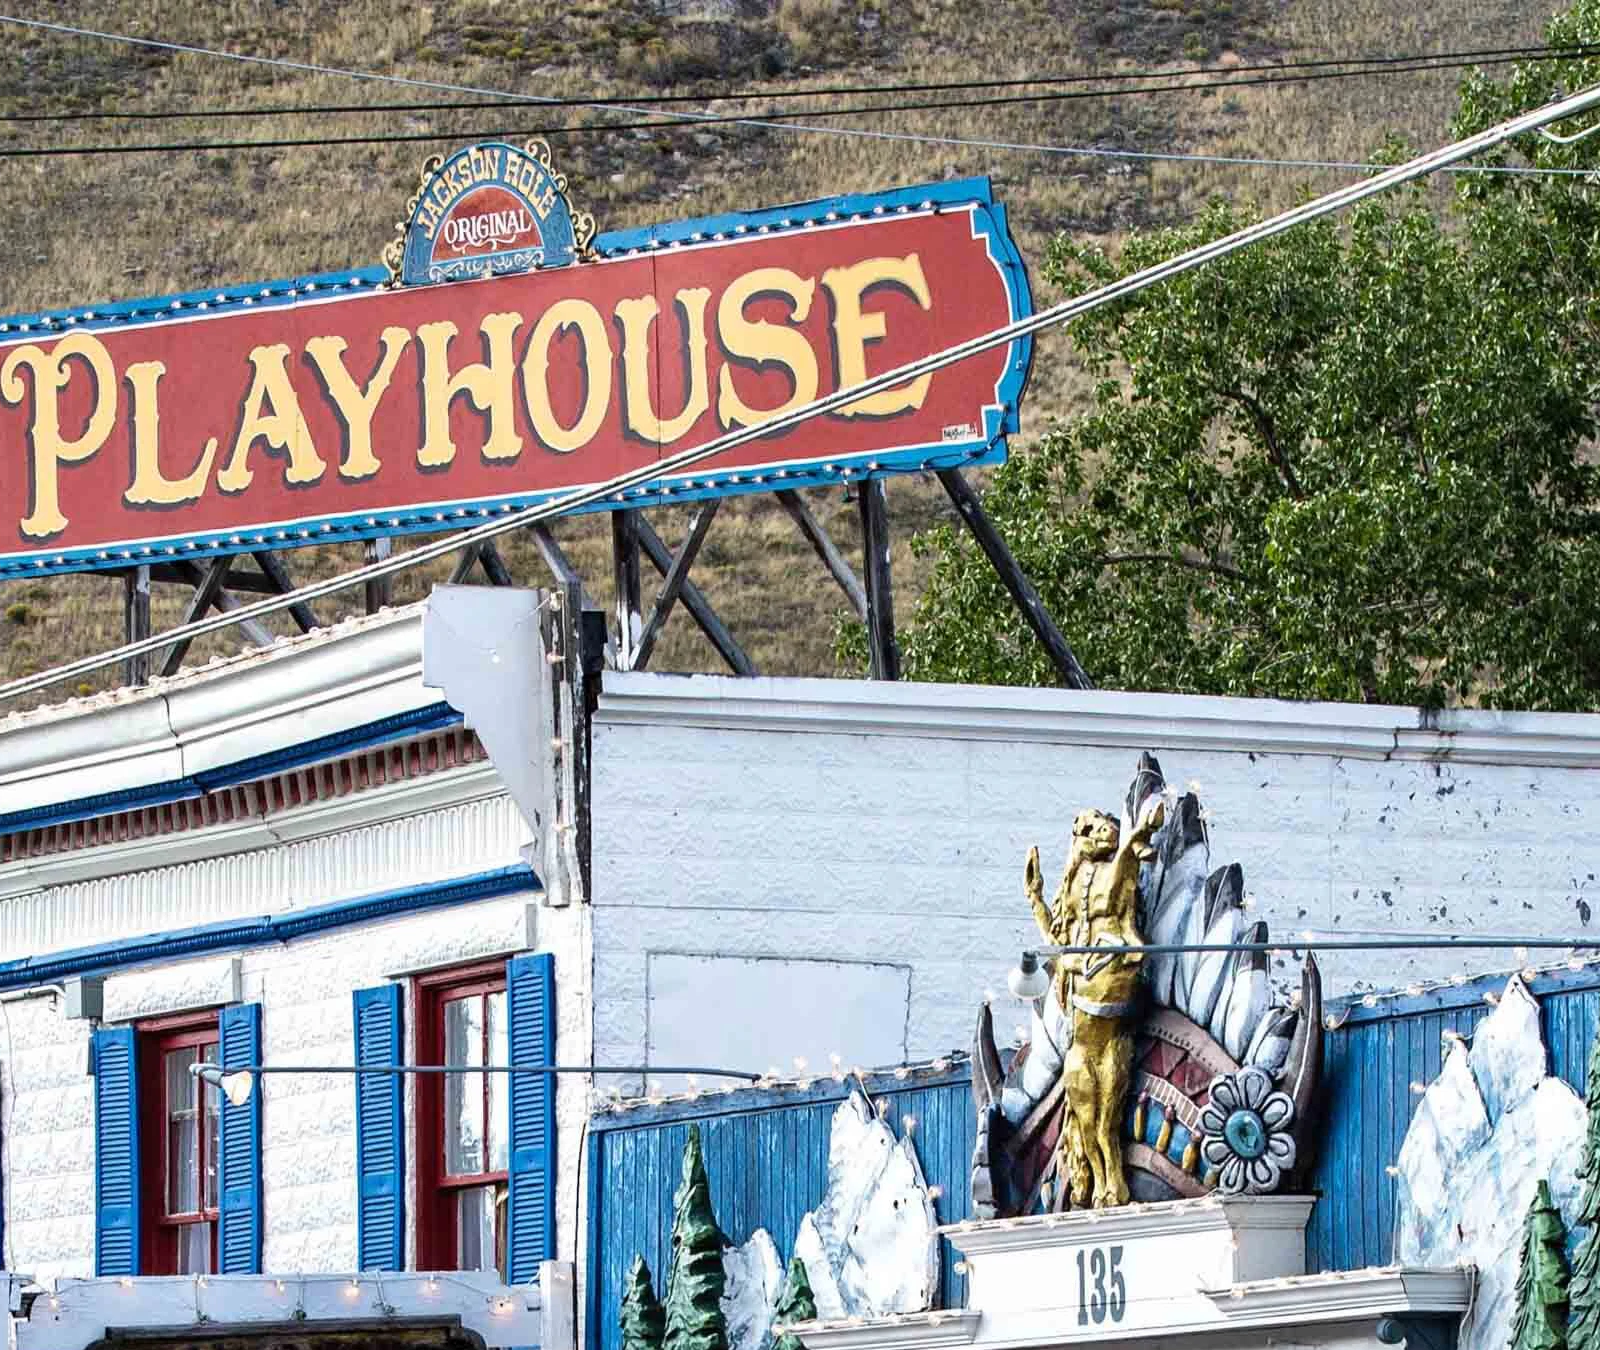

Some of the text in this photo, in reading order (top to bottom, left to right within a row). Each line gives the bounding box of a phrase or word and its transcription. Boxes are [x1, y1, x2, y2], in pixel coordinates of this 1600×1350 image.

[417, 147, 558, 240] JACKSON HOLE
[443, 208, 531, 246] ORIGINAL
[0, 253, 933, 538] PLAYHOUSE
[1076, 1245, 1126, 1326] 135
